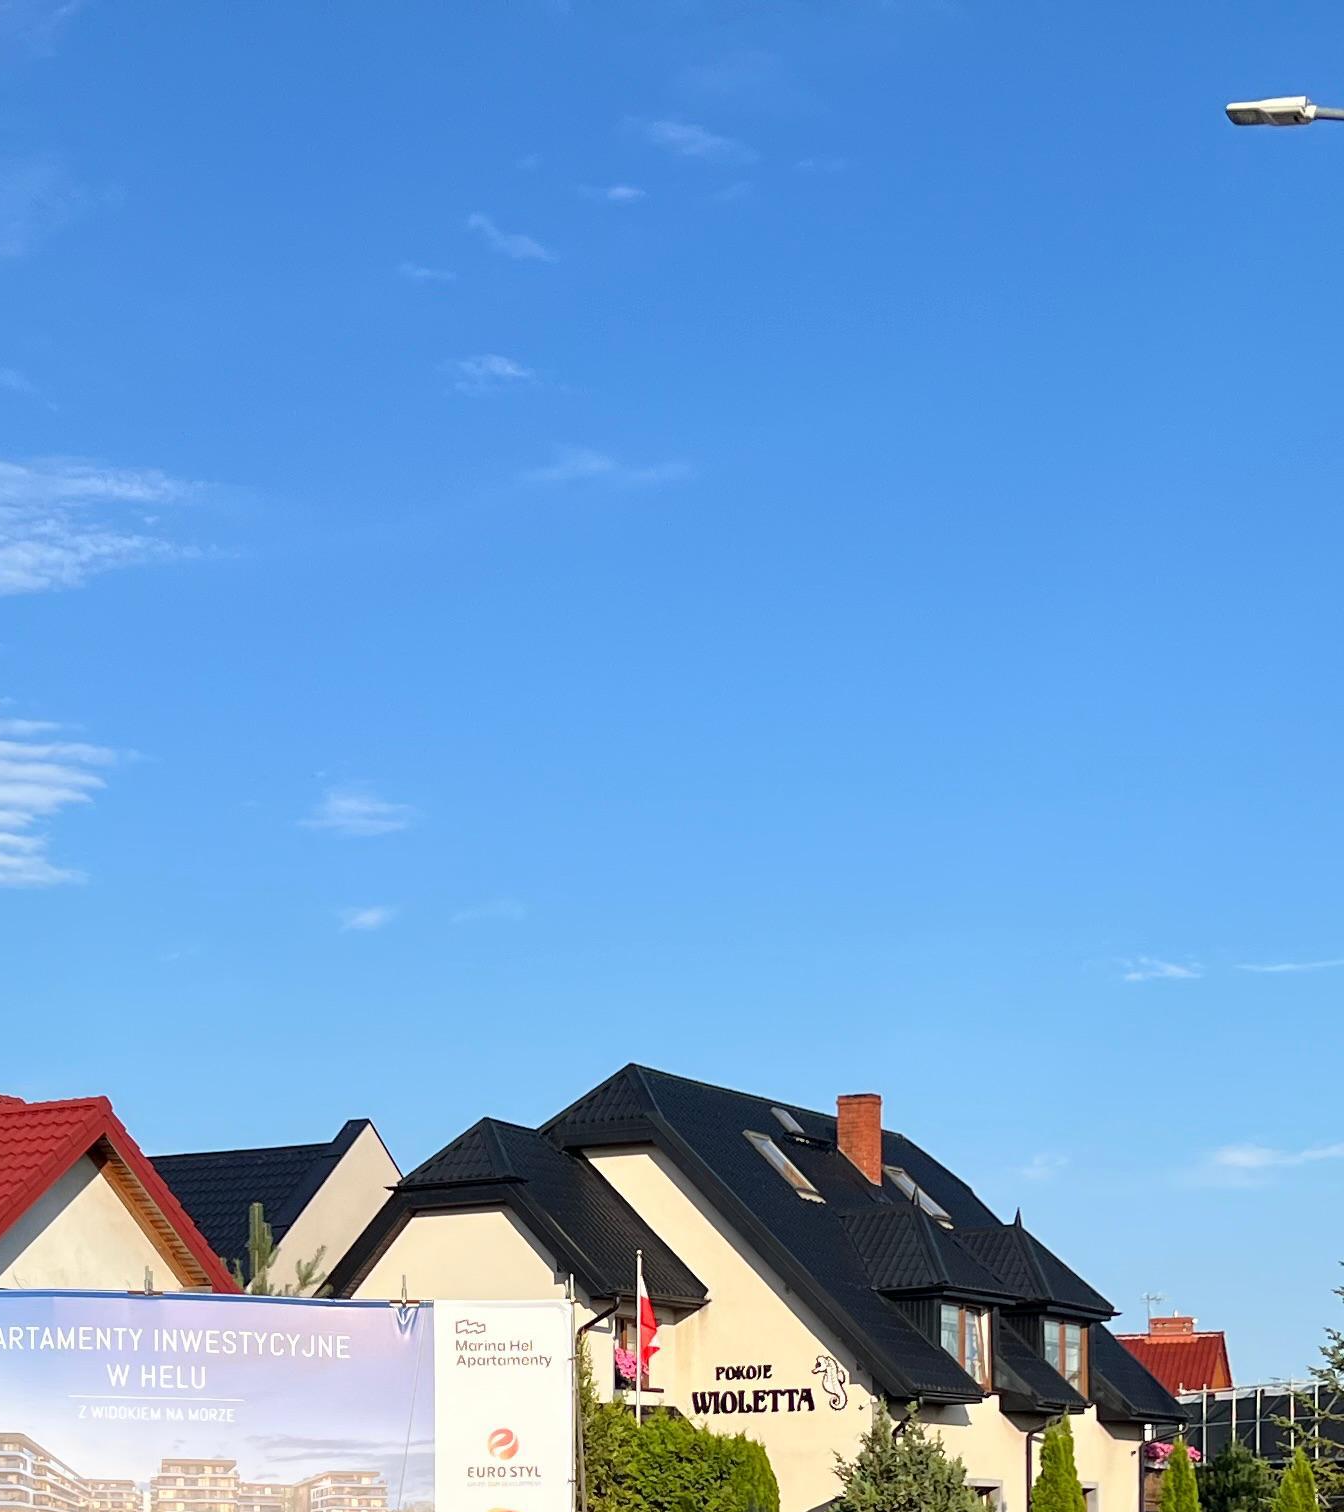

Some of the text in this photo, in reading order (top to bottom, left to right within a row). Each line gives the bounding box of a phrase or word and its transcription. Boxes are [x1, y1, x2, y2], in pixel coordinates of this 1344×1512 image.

[154, 1329, 352, 1359] INWESTYCYJNE
[455, 1340, 533, 1351] Marina Hel
[456, 1355, 552, 1368] Apartamenty
[107, 1363, 207, 1389] W HELU
[715, 1365, 773, 1380] POKOJE
[692, 1388, 816, 1414] WIOLETTA
[78, 1405, 236, 1423] Z WIDOKIEM NA MORZE
[467, 1466, 542, 1478] EURO STYL
